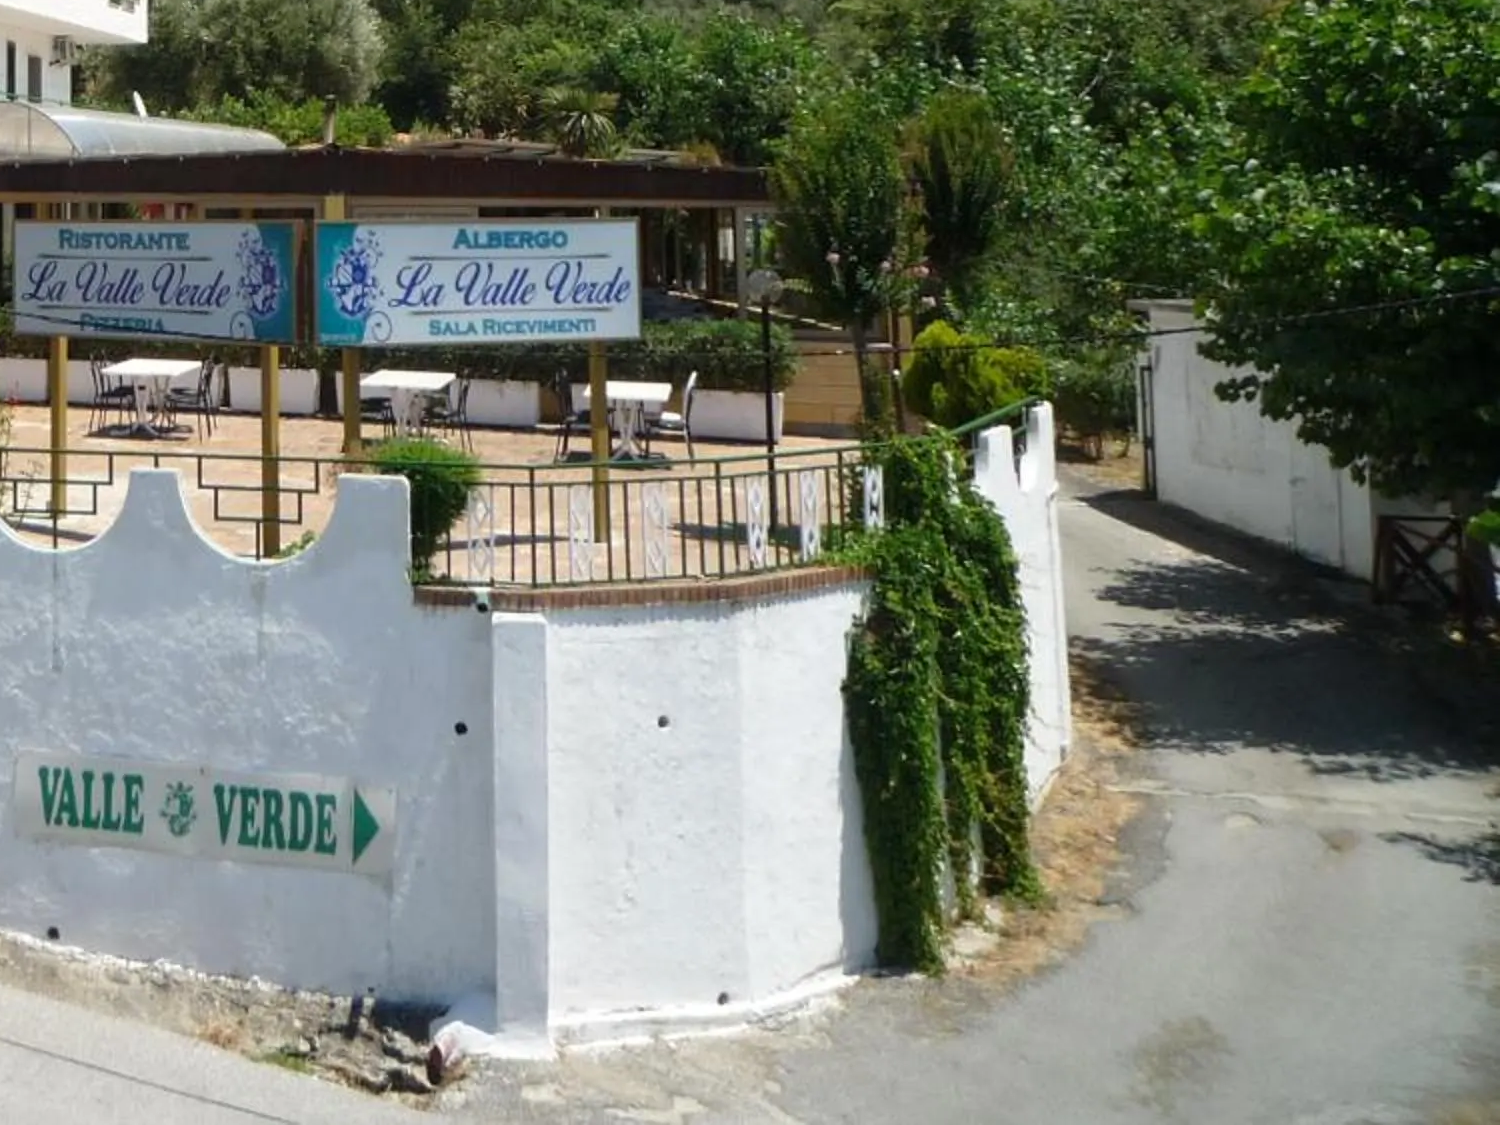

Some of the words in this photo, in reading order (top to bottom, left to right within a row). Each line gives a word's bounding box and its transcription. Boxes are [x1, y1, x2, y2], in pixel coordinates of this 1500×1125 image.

[58, 228, 191, 251] RISTORANTE
[453, 228, 569, 250] ALBERGO
[21, 260, 68, 303] La
[75, 261, 146, 306] Valle
[151, 262, 231, 309] Verde
[387, 262, 445, 308] La
[454, 261, 538, 306] Valle
[545, 260, 632, 305] Verde
[428, 319, 479, 337] SALA
[482, 317, 597, 336] RICEVIMENTI
[38, 766, 145, 835] VALLE
[213, 784, 337, 856] VERDE
